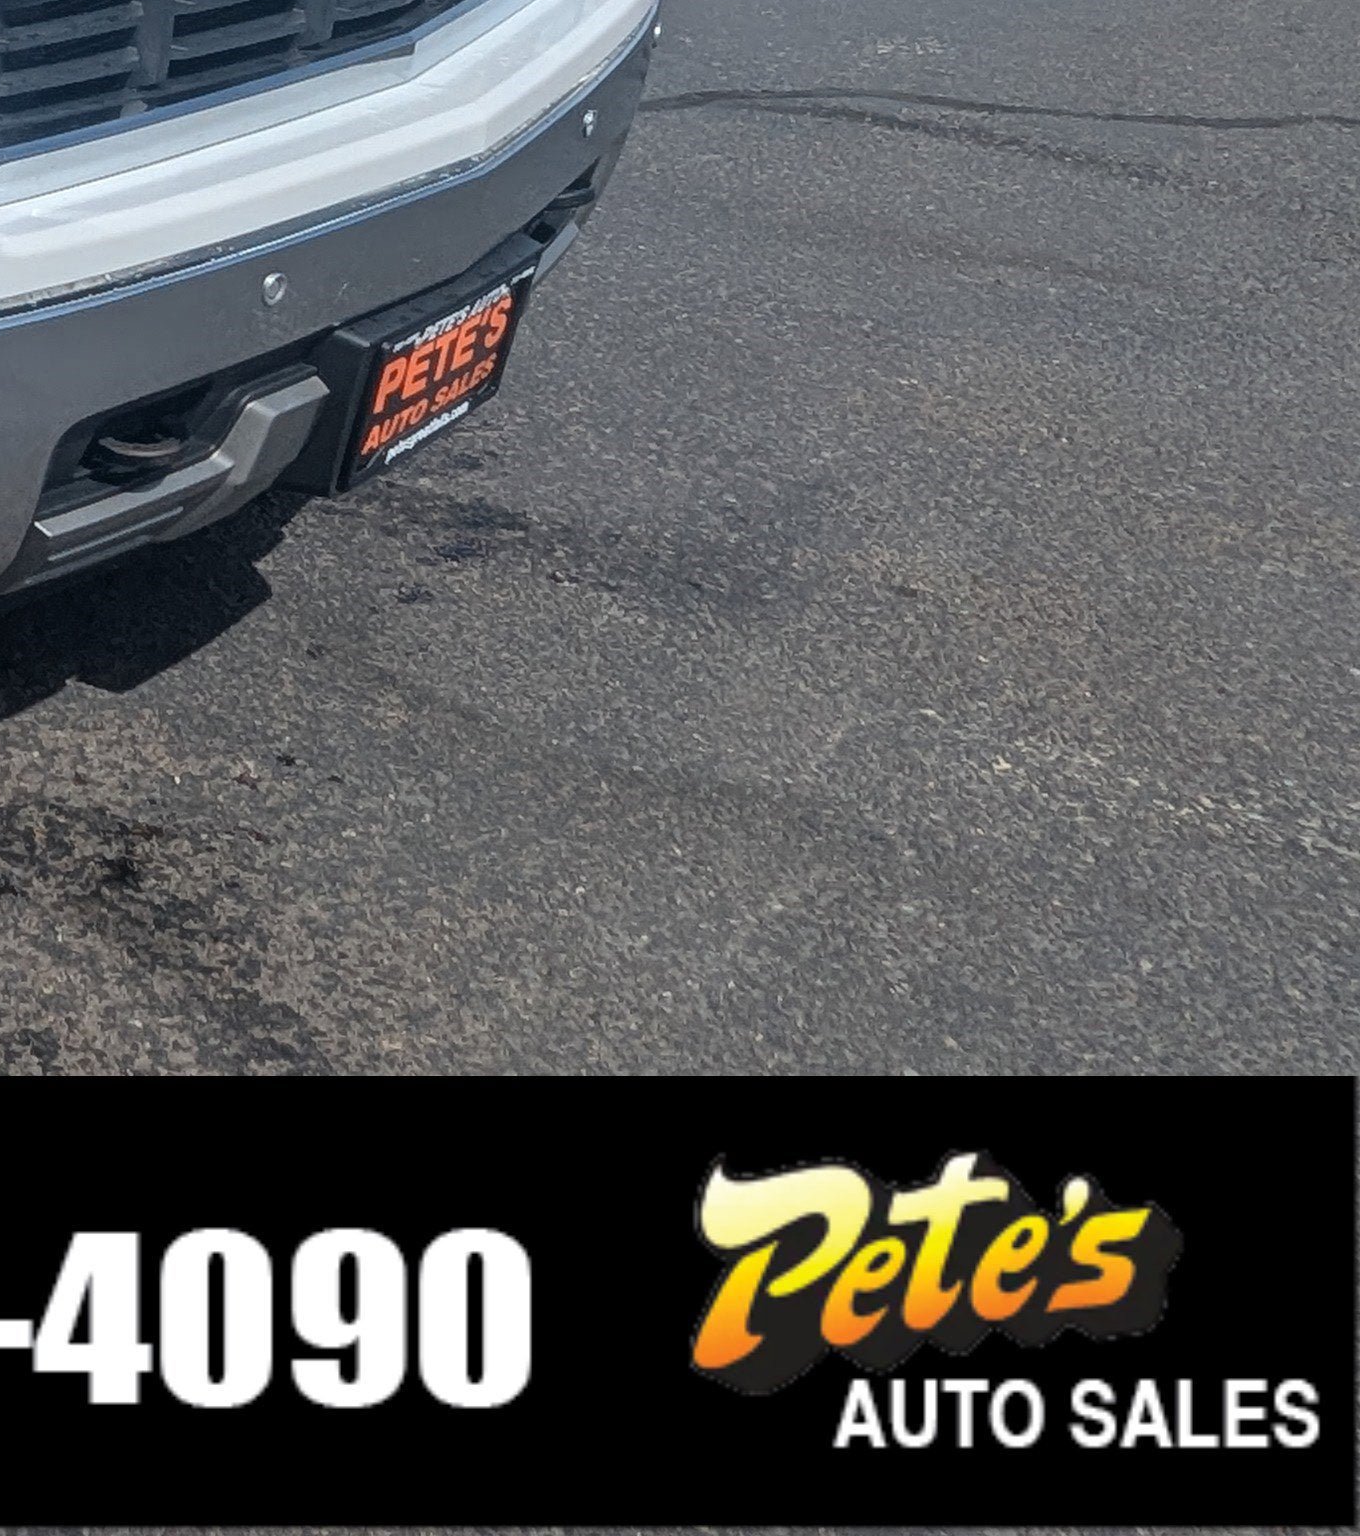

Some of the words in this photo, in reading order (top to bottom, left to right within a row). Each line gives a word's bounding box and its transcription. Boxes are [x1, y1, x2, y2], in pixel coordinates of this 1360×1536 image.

[361, 398, 429, 455] AUTO
[430, 352, 498, 413] SALES
[373, 293, 513, 414] PETE'S
